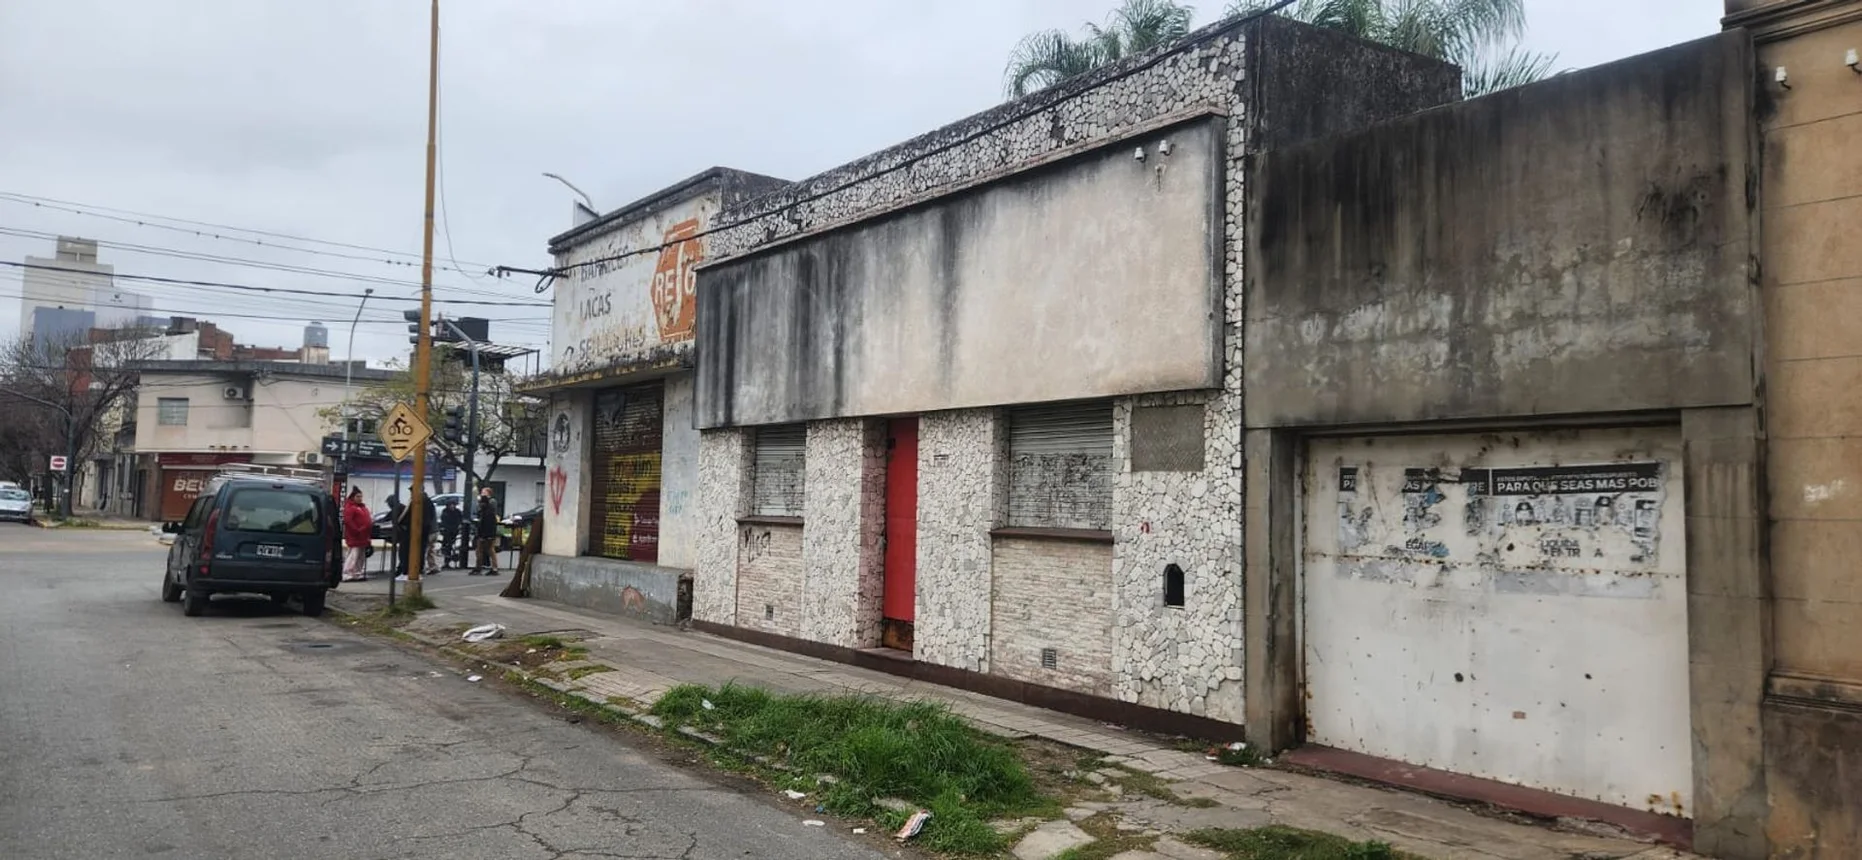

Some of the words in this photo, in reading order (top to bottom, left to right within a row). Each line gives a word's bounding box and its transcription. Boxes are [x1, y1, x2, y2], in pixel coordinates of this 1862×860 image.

[1497, 481, 1531, 493] PARA
[1560, 478, 1594, 491] SEAS
[1596, 477, 1627, 490] MAS
